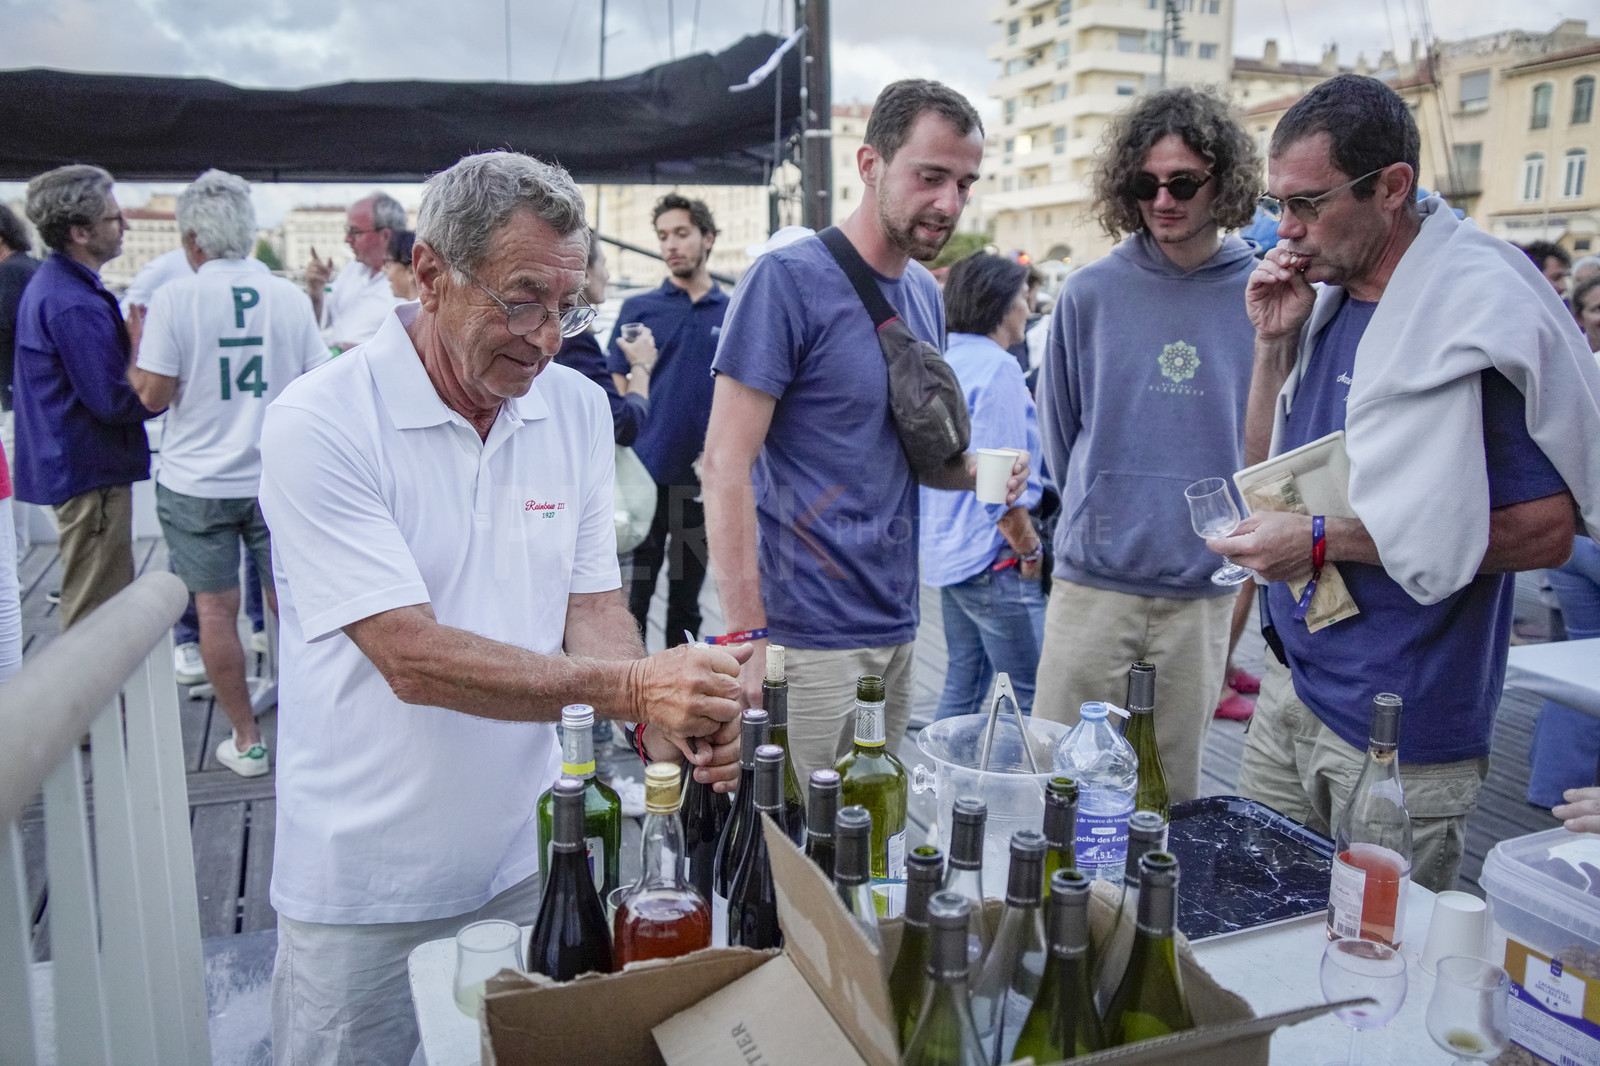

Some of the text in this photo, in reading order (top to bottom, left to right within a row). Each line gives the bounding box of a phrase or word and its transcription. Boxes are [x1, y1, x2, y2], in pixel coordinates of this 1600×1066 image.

[231, 286, 260, 328] P
[219, 354, 268, 400] 14
[525, 499, 556, 511] Rainbow
[1075, 835, 1096, 843] oche
